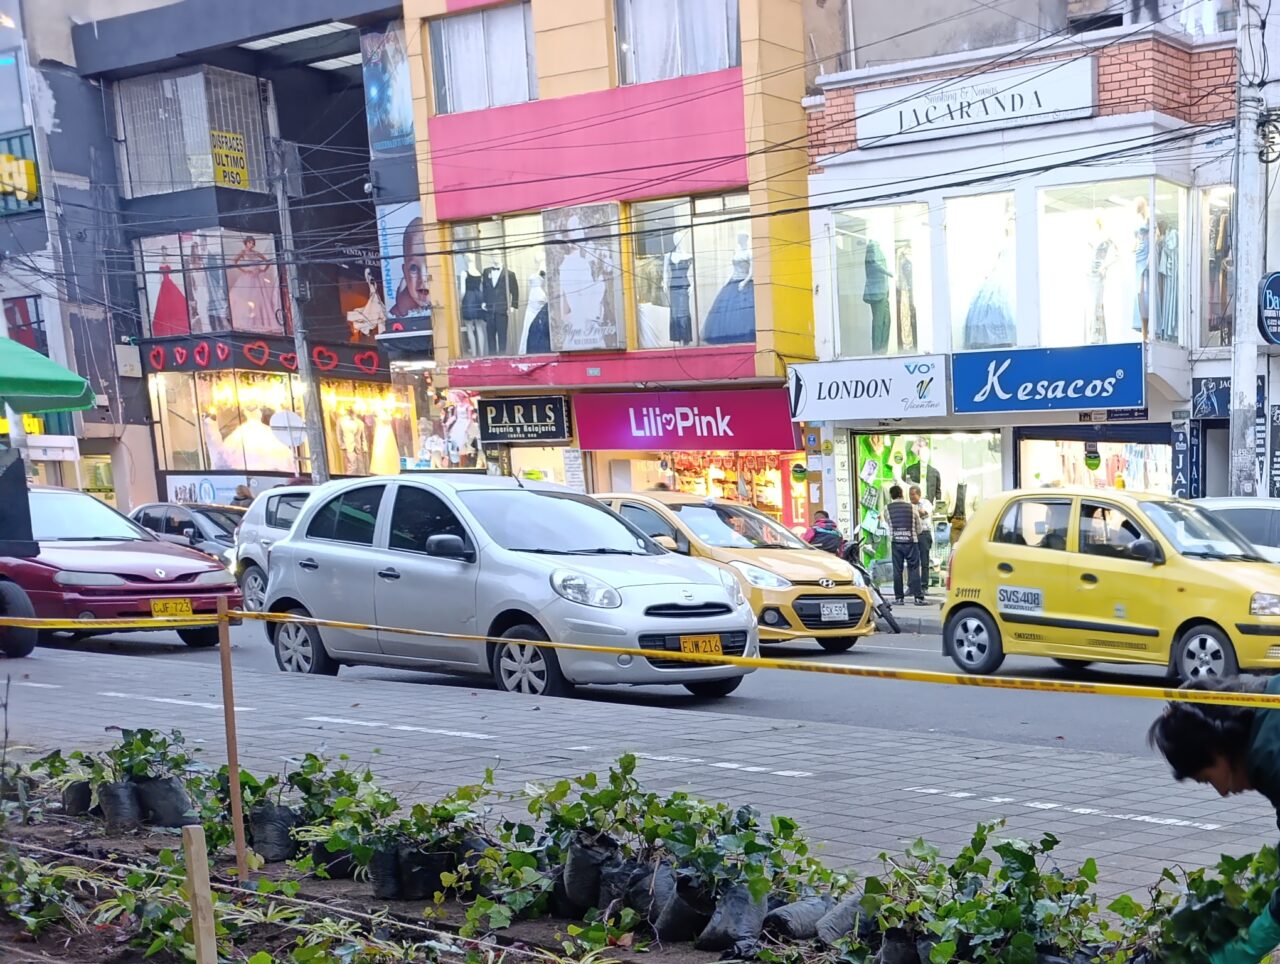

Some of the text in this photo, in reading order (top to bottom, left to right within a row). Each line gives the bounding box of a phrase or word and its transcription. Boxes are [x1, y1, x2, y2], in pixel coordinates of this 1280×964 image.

[960, 87, 969, 100] &
[898, 89, 1043, 131] JACARANDA
[211, 133, 244, 153] DISFRACES
[214, 152, 245, 170] ULTIMO
[223, 169, 242, 185] PISO
[816, 378, 893, 401] LONDON
[486, 403, 556, 425] PARIS
[173, 600, 191, 613] 723
